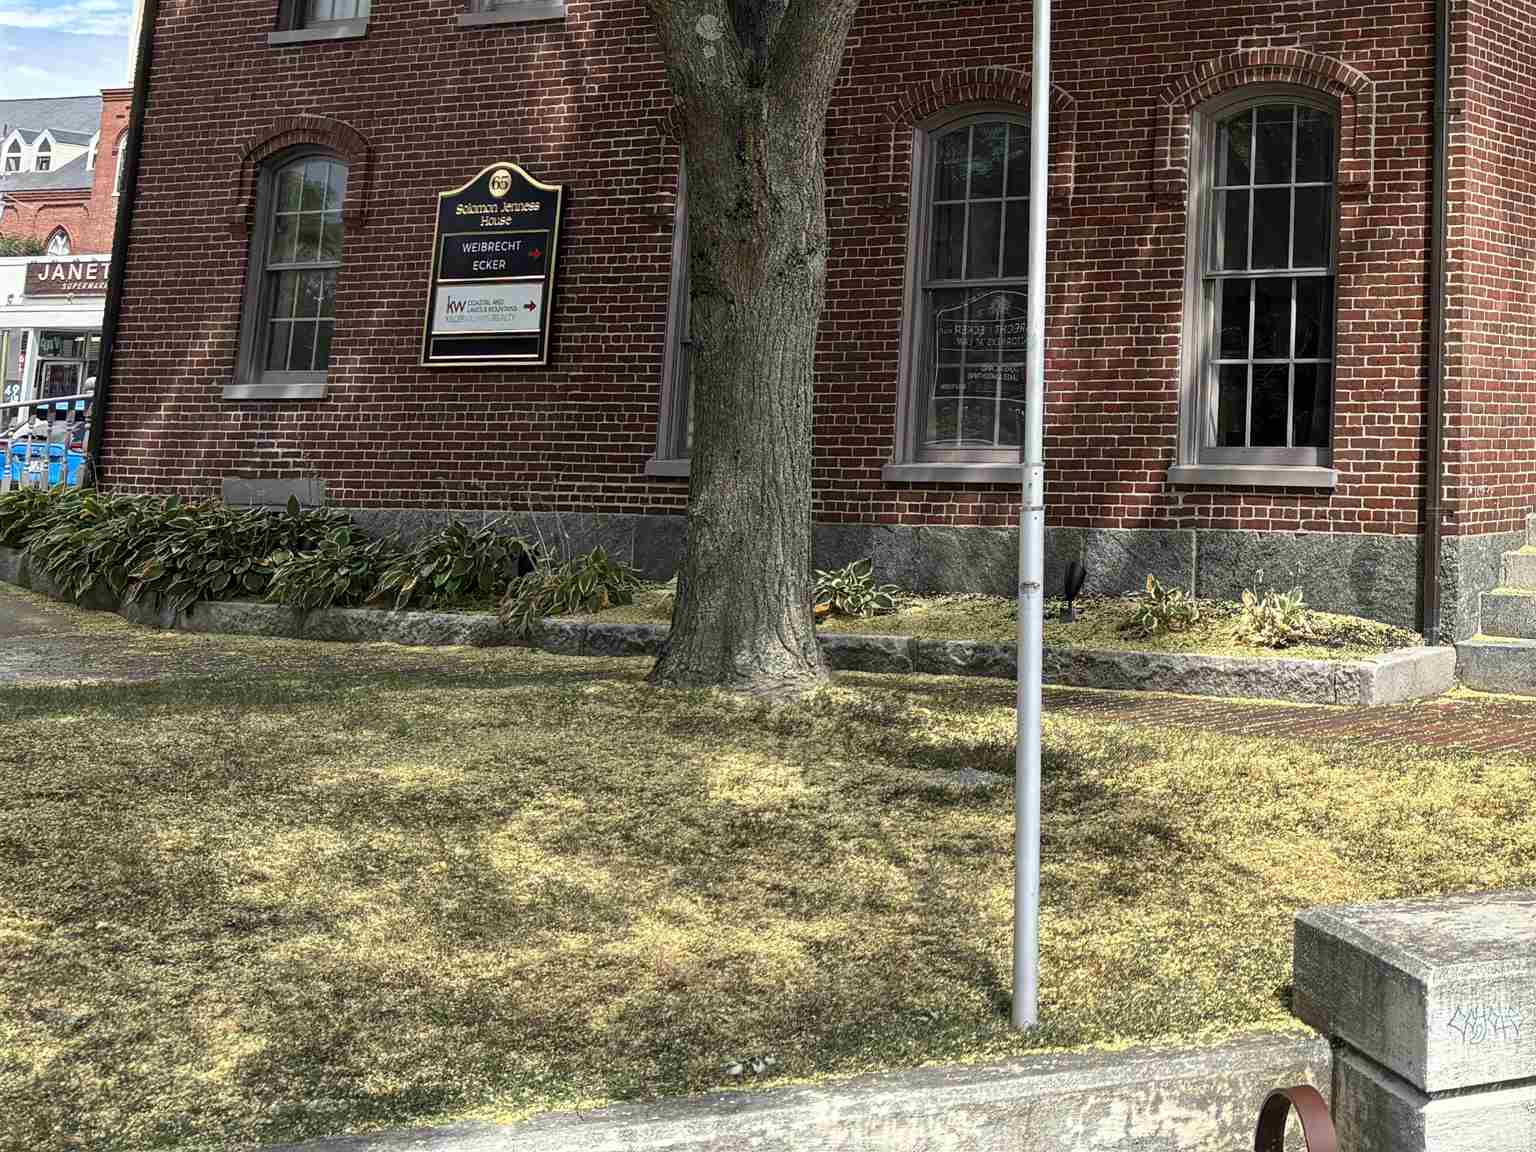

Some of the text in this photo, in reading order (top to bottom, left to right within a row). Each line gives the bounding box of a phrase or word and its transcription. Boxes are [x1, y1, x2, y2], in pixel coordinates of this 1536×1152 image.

[492, 175, 510, 190] 65
[456, 201, 541, 215] Solomon Jenness
[480, 215, 512, 226] House
[462, 240, 522, 253] WEIBRECHT
[473, 259, 506, 271] ECKER
